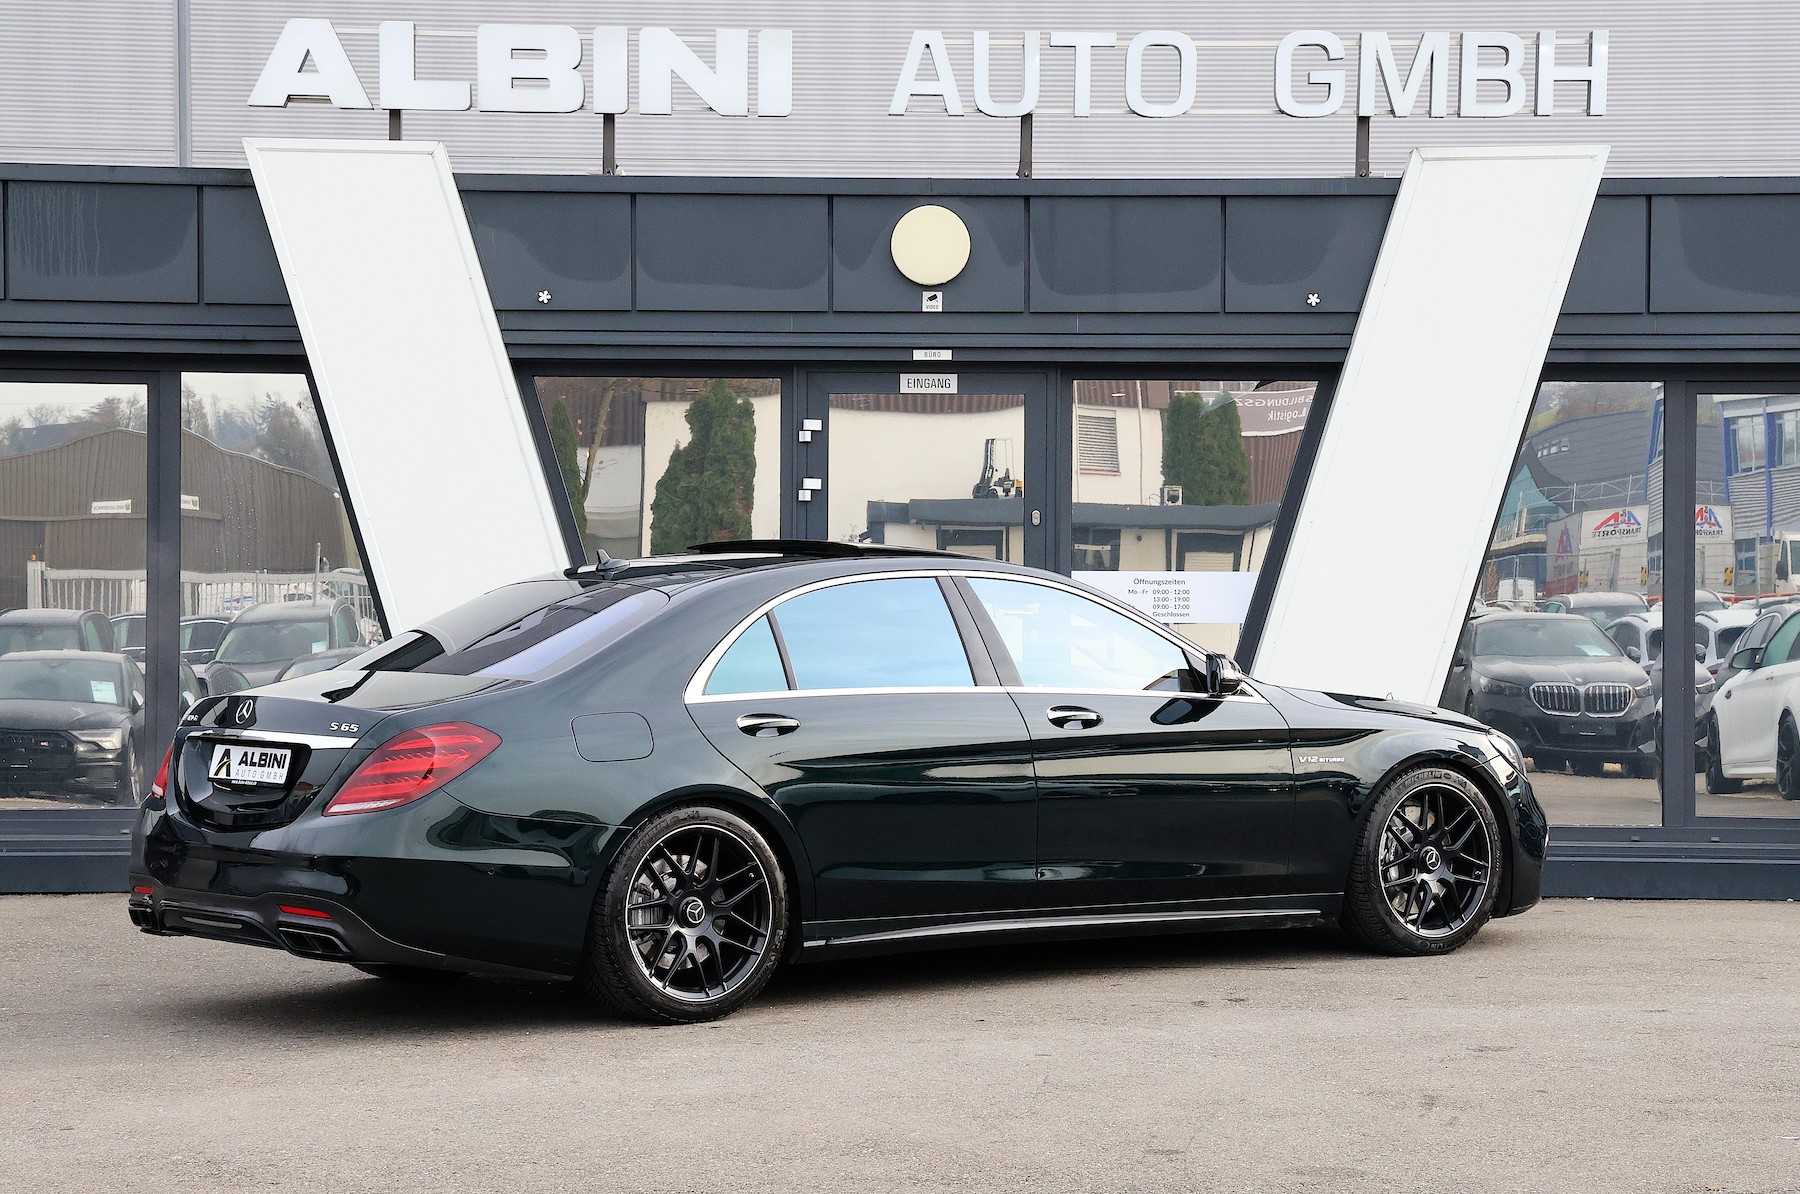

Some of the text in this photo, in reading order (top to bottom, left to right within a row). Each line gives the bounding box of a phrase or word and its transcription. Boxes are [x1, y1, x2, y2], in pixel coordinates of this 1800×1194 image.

[248, 18, 1609, 118] ALBINI AUTO GMBH
[907, 378, 951, 388] EINGANG
[1133, 577, 1186, 586] Öffnungszeiten
[329, 722, 360, 733] S 65
[238, 751, 287, 769] ALBINI
[1298, 755, 1318, 763] V12
[235, 768, 284, 780] AUTO GMBH
